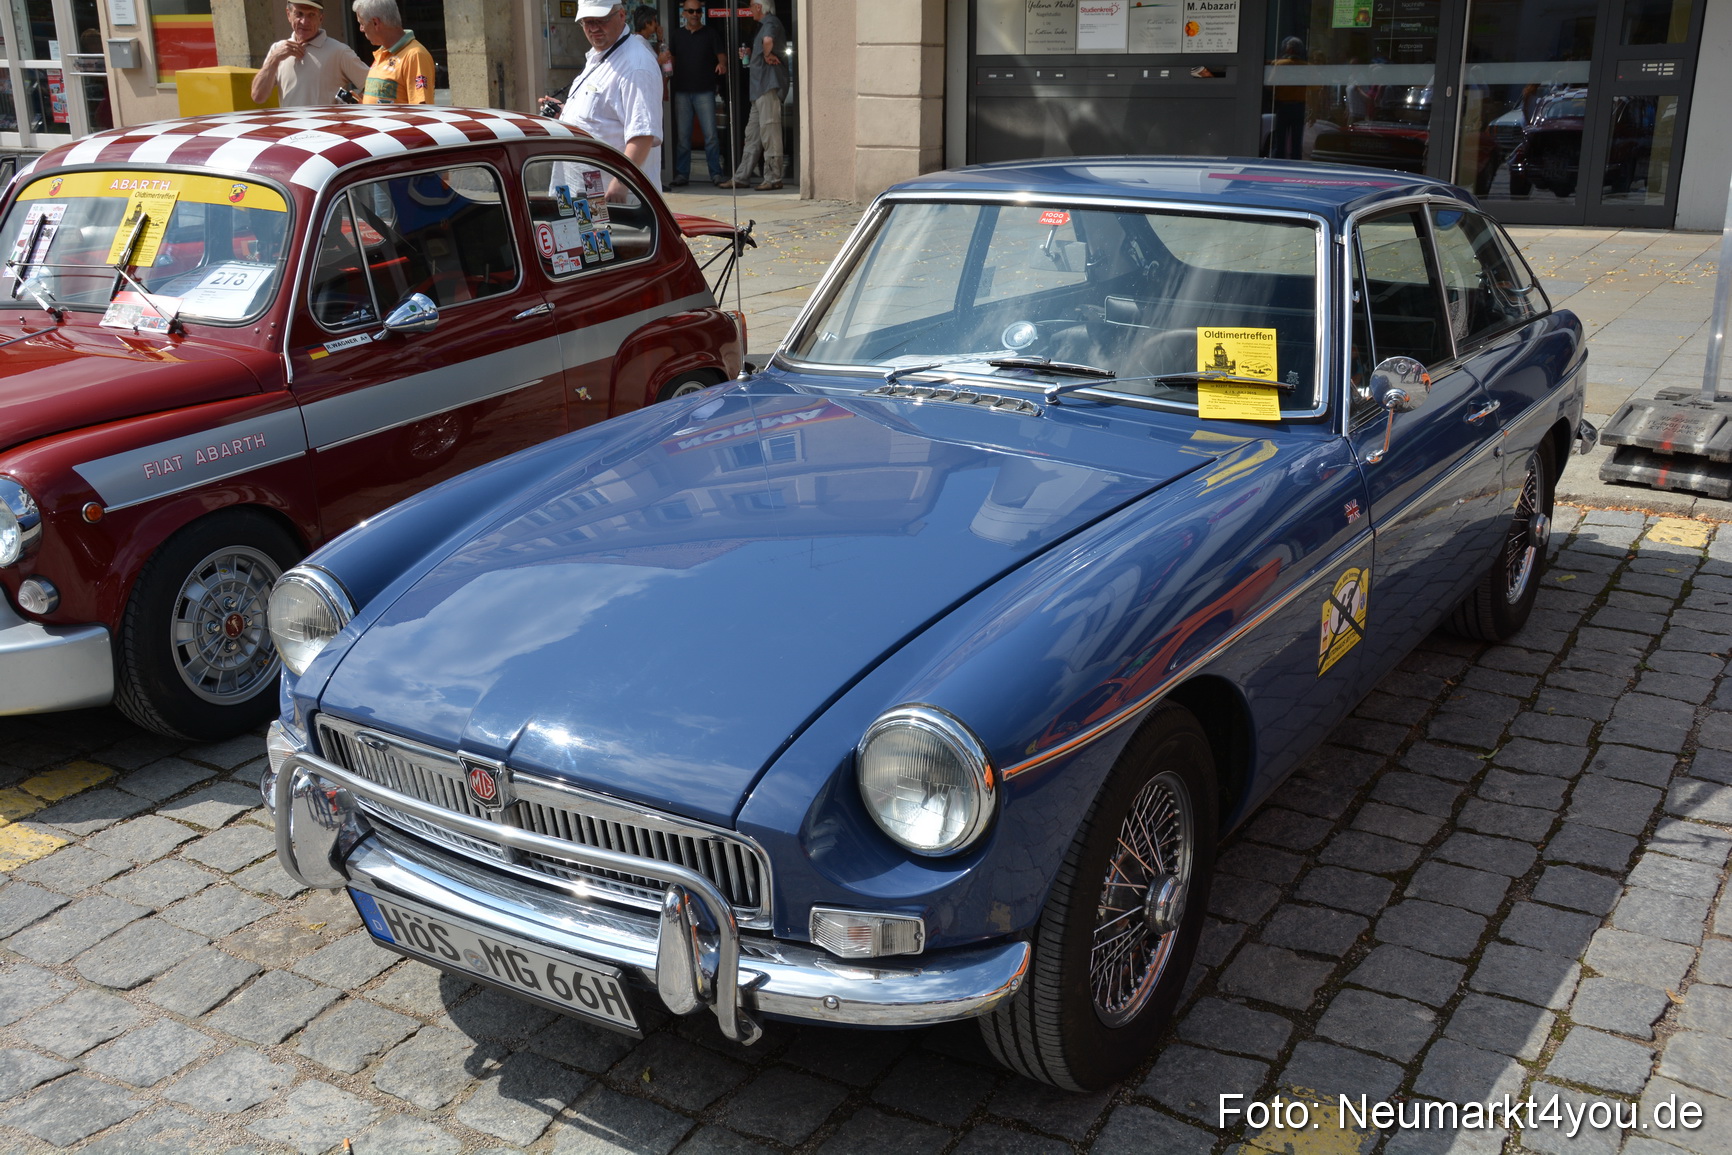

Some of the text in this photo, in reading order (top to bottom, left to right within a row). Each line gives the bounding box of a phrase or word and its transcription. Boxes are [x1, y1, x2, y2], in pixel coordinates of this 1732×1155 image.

[1054, 0, 1075, 8] Nails
[1187, 1, 1237, 10] M. Abazari
[109, 179, 172, 191] ABARTH
[134, 191, 175, 200] Oldtimertreffen
[541, 231, 551, 251] E
[210, 271, 248, 286] 278
[1204, 330, 1274, 340] Oldtimertreffen
[326, 337, 358, 350] R.WAGNER
[143, 432, 267, 479] FIAT ABARTH
[471, 771, 495, 798] MG
[372, 919, 384, 931] D
[378, 903, 632, 1021] HÖS MG 66H
